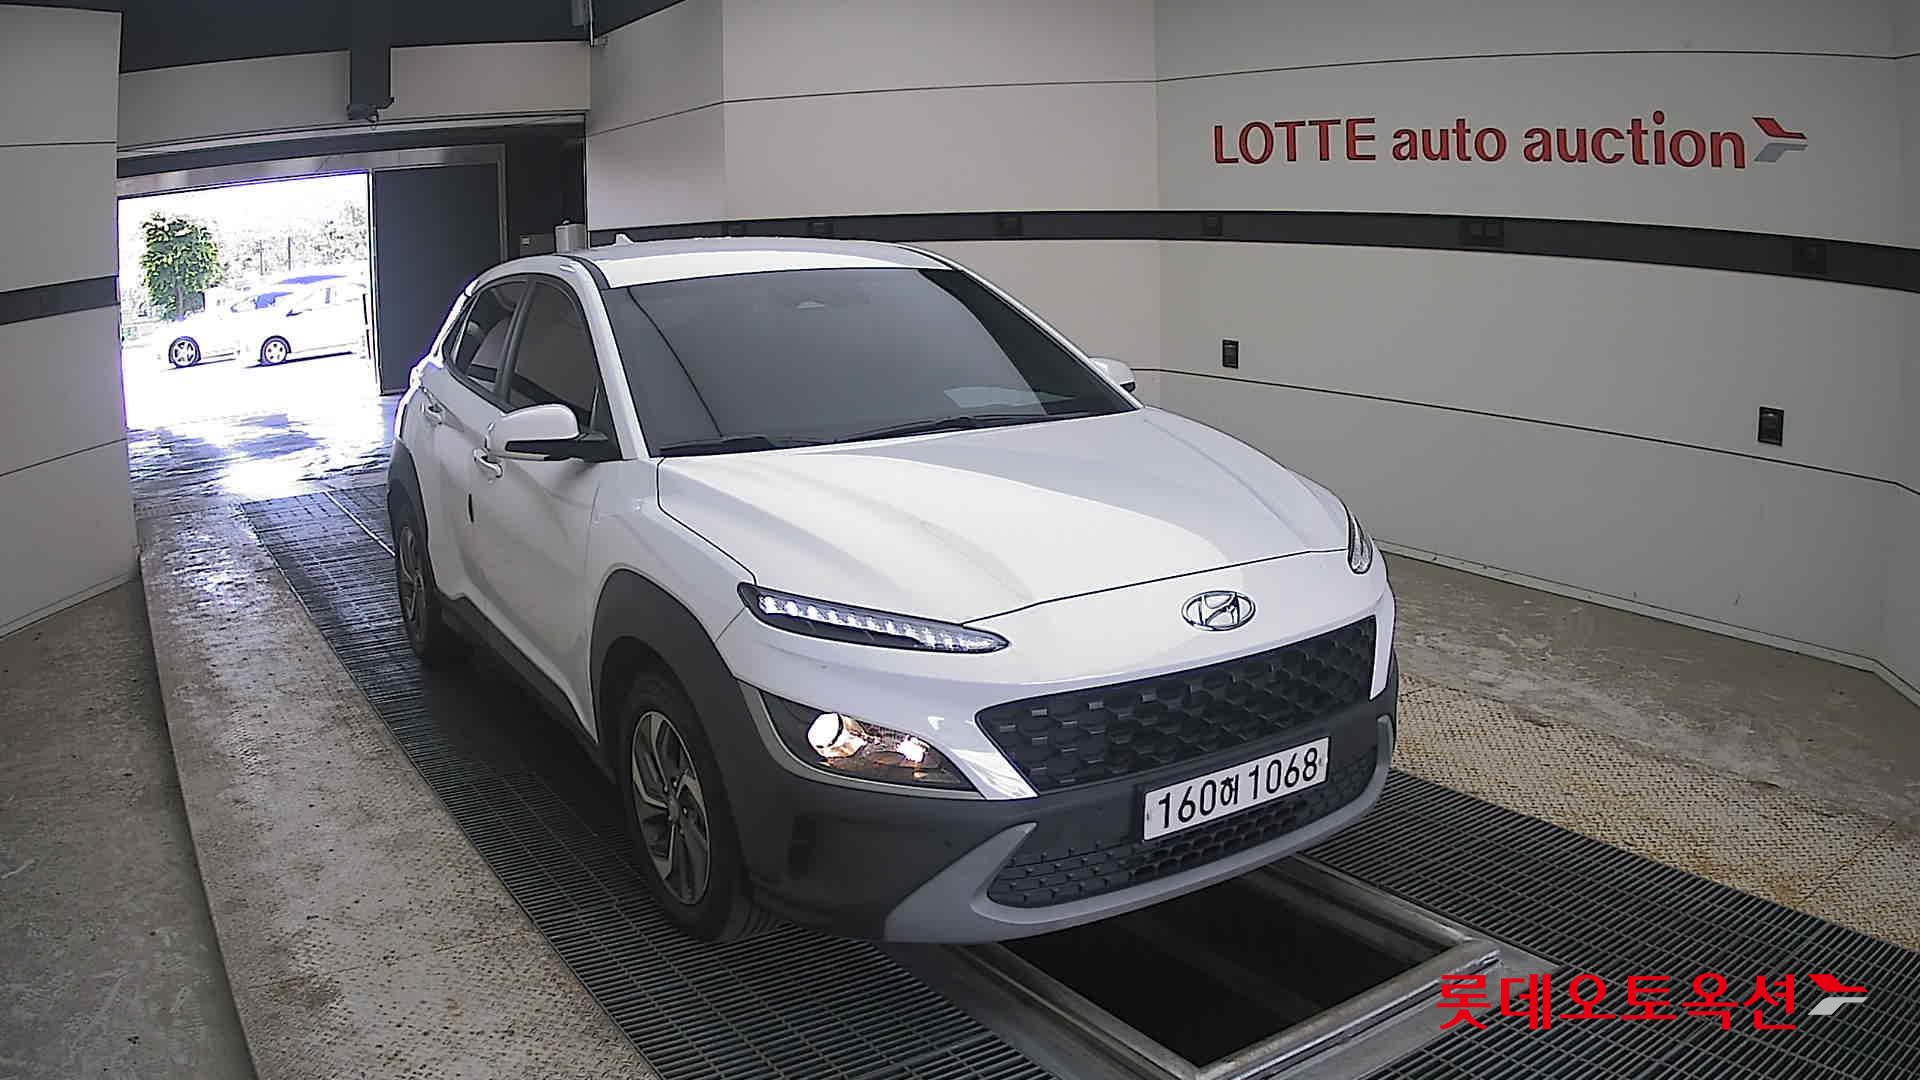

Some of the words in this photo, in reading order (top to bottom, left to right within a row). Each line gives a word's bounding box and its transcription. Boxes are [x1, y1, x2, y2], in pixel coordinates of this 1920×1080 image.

[1213, 117, 1376, 164] LOTTE
[1391, 118, 1507, 163] auto
[1522, 110, 1746, 169] auction
[1158, 774, 1239, 829] 160허
[1248, 747, 1318, 799] 1068
